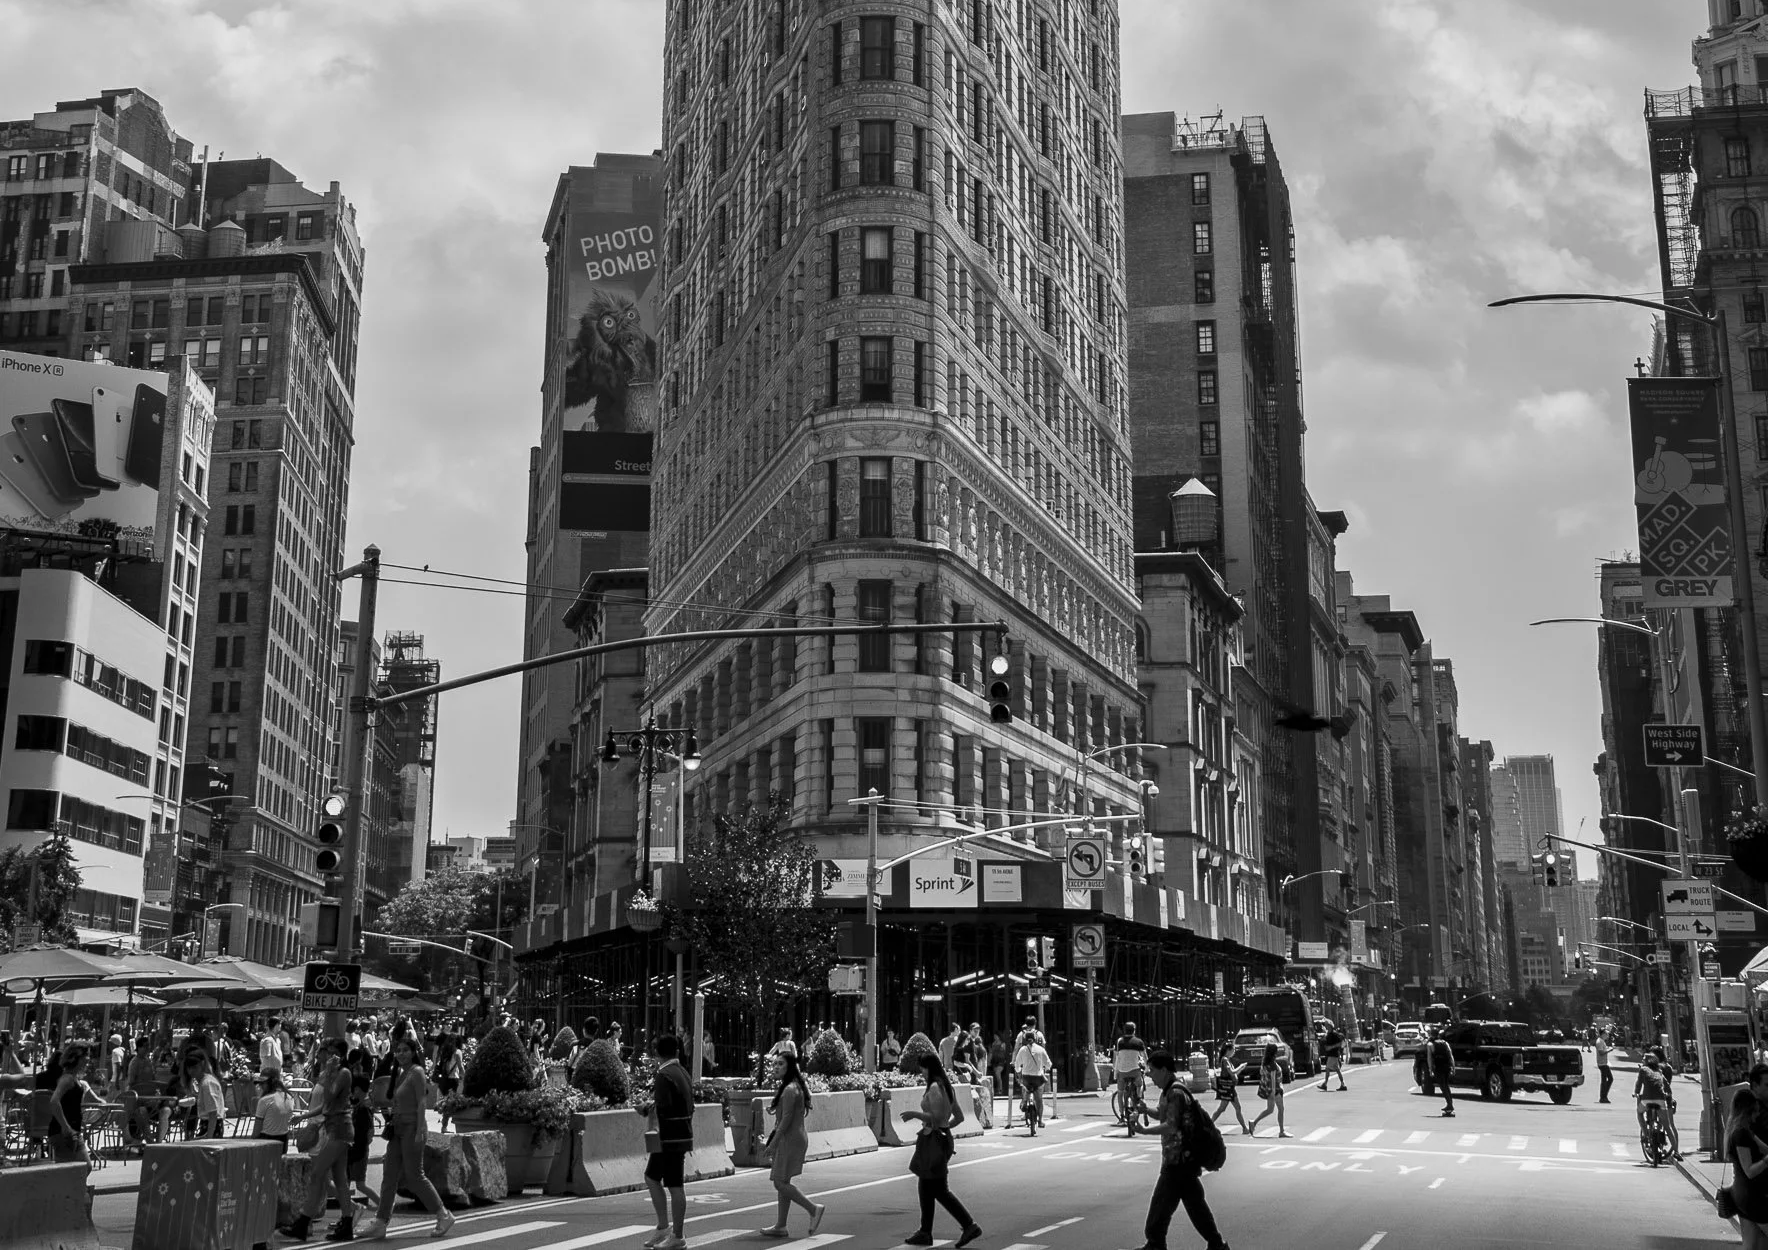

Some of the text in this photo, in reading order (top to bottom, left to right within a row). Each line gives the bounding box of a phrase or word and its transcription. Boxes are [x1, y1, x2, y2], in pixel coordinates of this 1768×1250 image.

[580, 225, 654, 257] PHOTO
[585, 248, 658, 281] BOMB!
[1, 357, 42, 373] iPhone
[614, 459, 652, 471] Street
[1639, 504, 1686, 548] MAD.
[1658, 539, 1695, 568] SQ.
[1694, 541, 1730, 572] PK.
[1655, 579, 1719, 597] GREY
[1648, 729, 1698, 738] West Side
[1652, 739, 1696, 751] Highway
[1704, 867, 1713, 876] 23
[915, 876, 955, 893] Sprint
[1689, 886, 1710, 894] TRUCK
[1690, 898, 1712, 906] ROUTE
[1668, 924, 1690, 932] LOCAL
[306, 995, 355, 1009] BIKE LANE
[1042, 1152, 1152, 1163] ONL
[1259, 1160, 1426, 1175] ONLY
